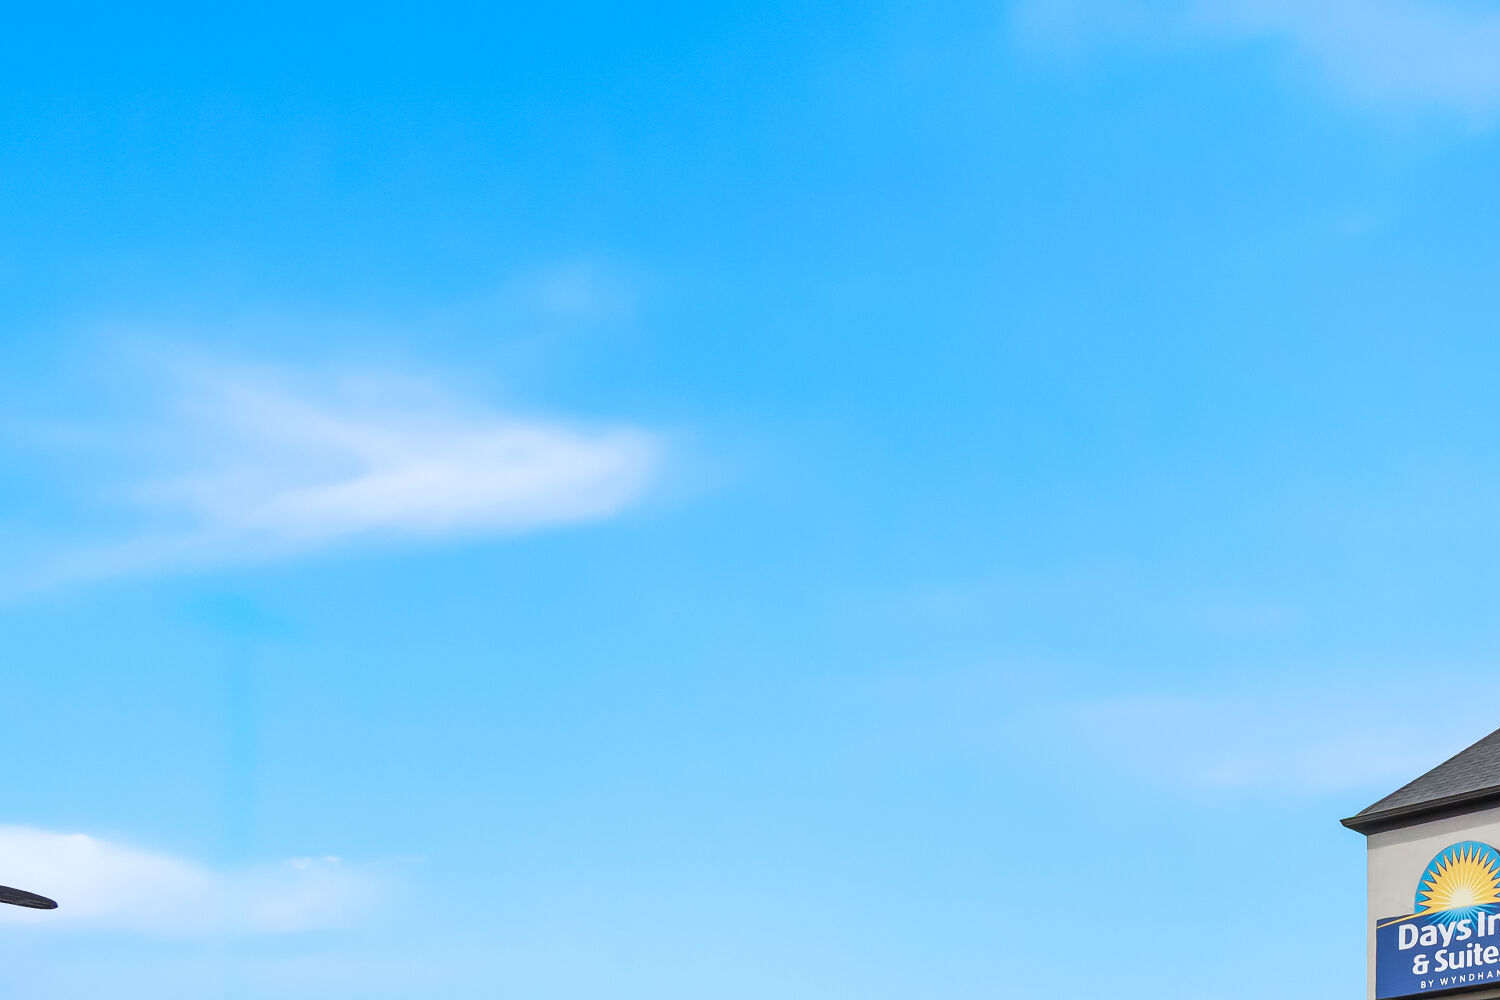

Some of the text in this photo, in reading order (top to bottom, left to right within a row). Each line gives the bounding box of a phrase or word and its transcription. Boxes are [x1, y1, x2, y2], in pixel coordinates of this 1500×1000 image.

[1398, 918, 1472, 950] Days
[1412, 954, 1430, 975] &
[1420, 979, 1434, 989] BY
